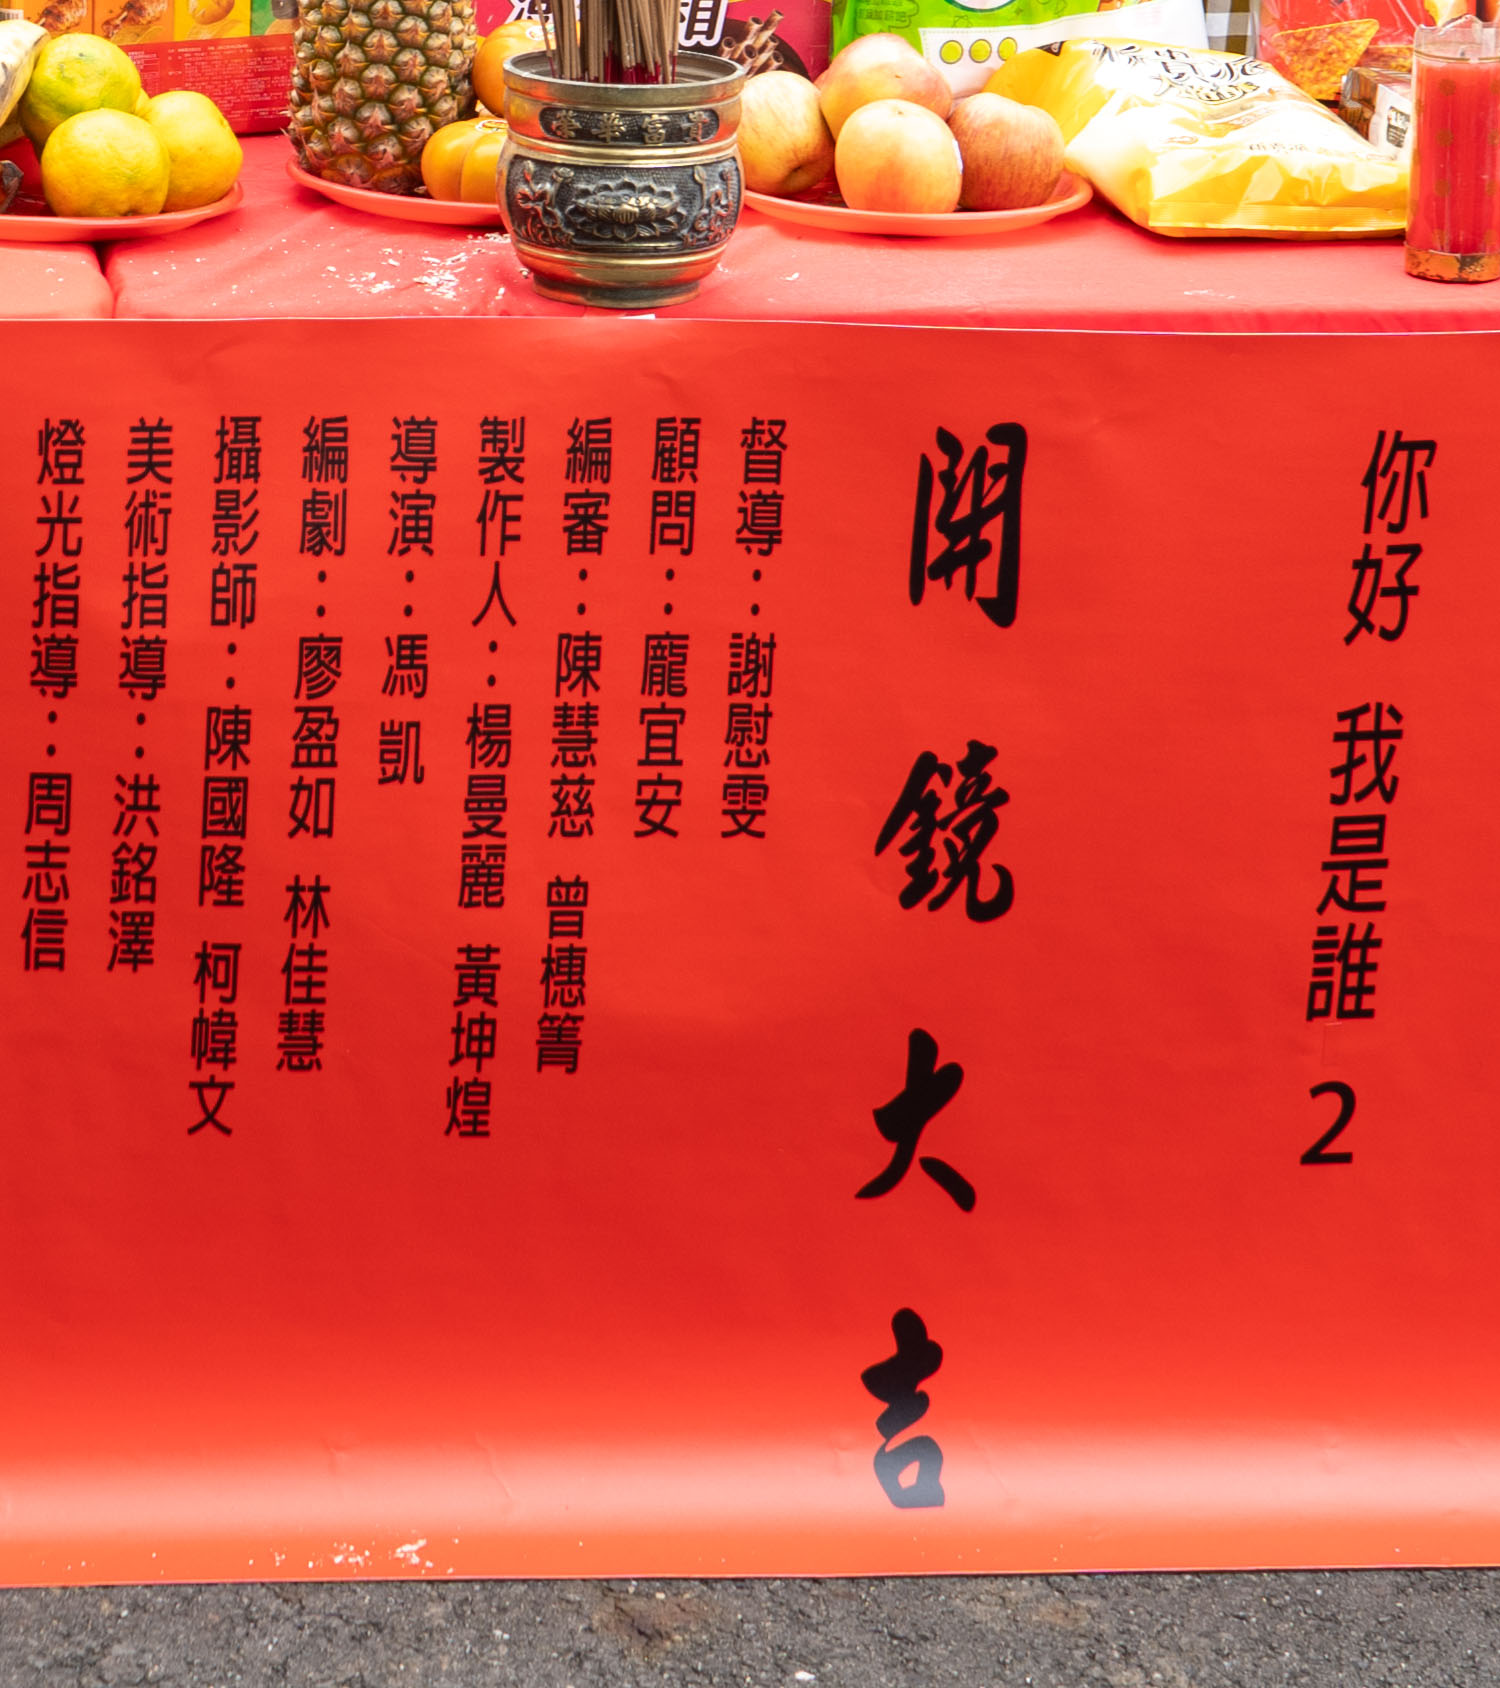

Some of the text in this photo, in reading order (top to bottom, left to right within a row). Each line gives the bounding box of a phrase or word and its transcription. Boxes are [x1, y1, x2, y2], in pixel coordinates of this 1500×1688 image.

[552, 109, 709, 143] 榮華富貴
[21, 419, 85, 971] 燈光指導：周志信
[107, 418, 173, 972] 美術指導：洪銘澤
[187, 417, 261, 1135] 攝影師：陳國隆 柯幃文
[277, 416, 348, 1071] 編劇：廖盈如 林佳慧
[445, 417, 525, 1137] 製作人：楊曼麗 黃坤煌
[549, 418, 612, 838] 編審：陳慧慈
[634, 417, 701, 838] 顧問：龐宜安
[721, 417, 787, 838] 督導：謝慰雯
[1301, 430, 1437, 1165] 你好 我是誰 2
[856, 423, 1028, 1506] 開鏡大吉
